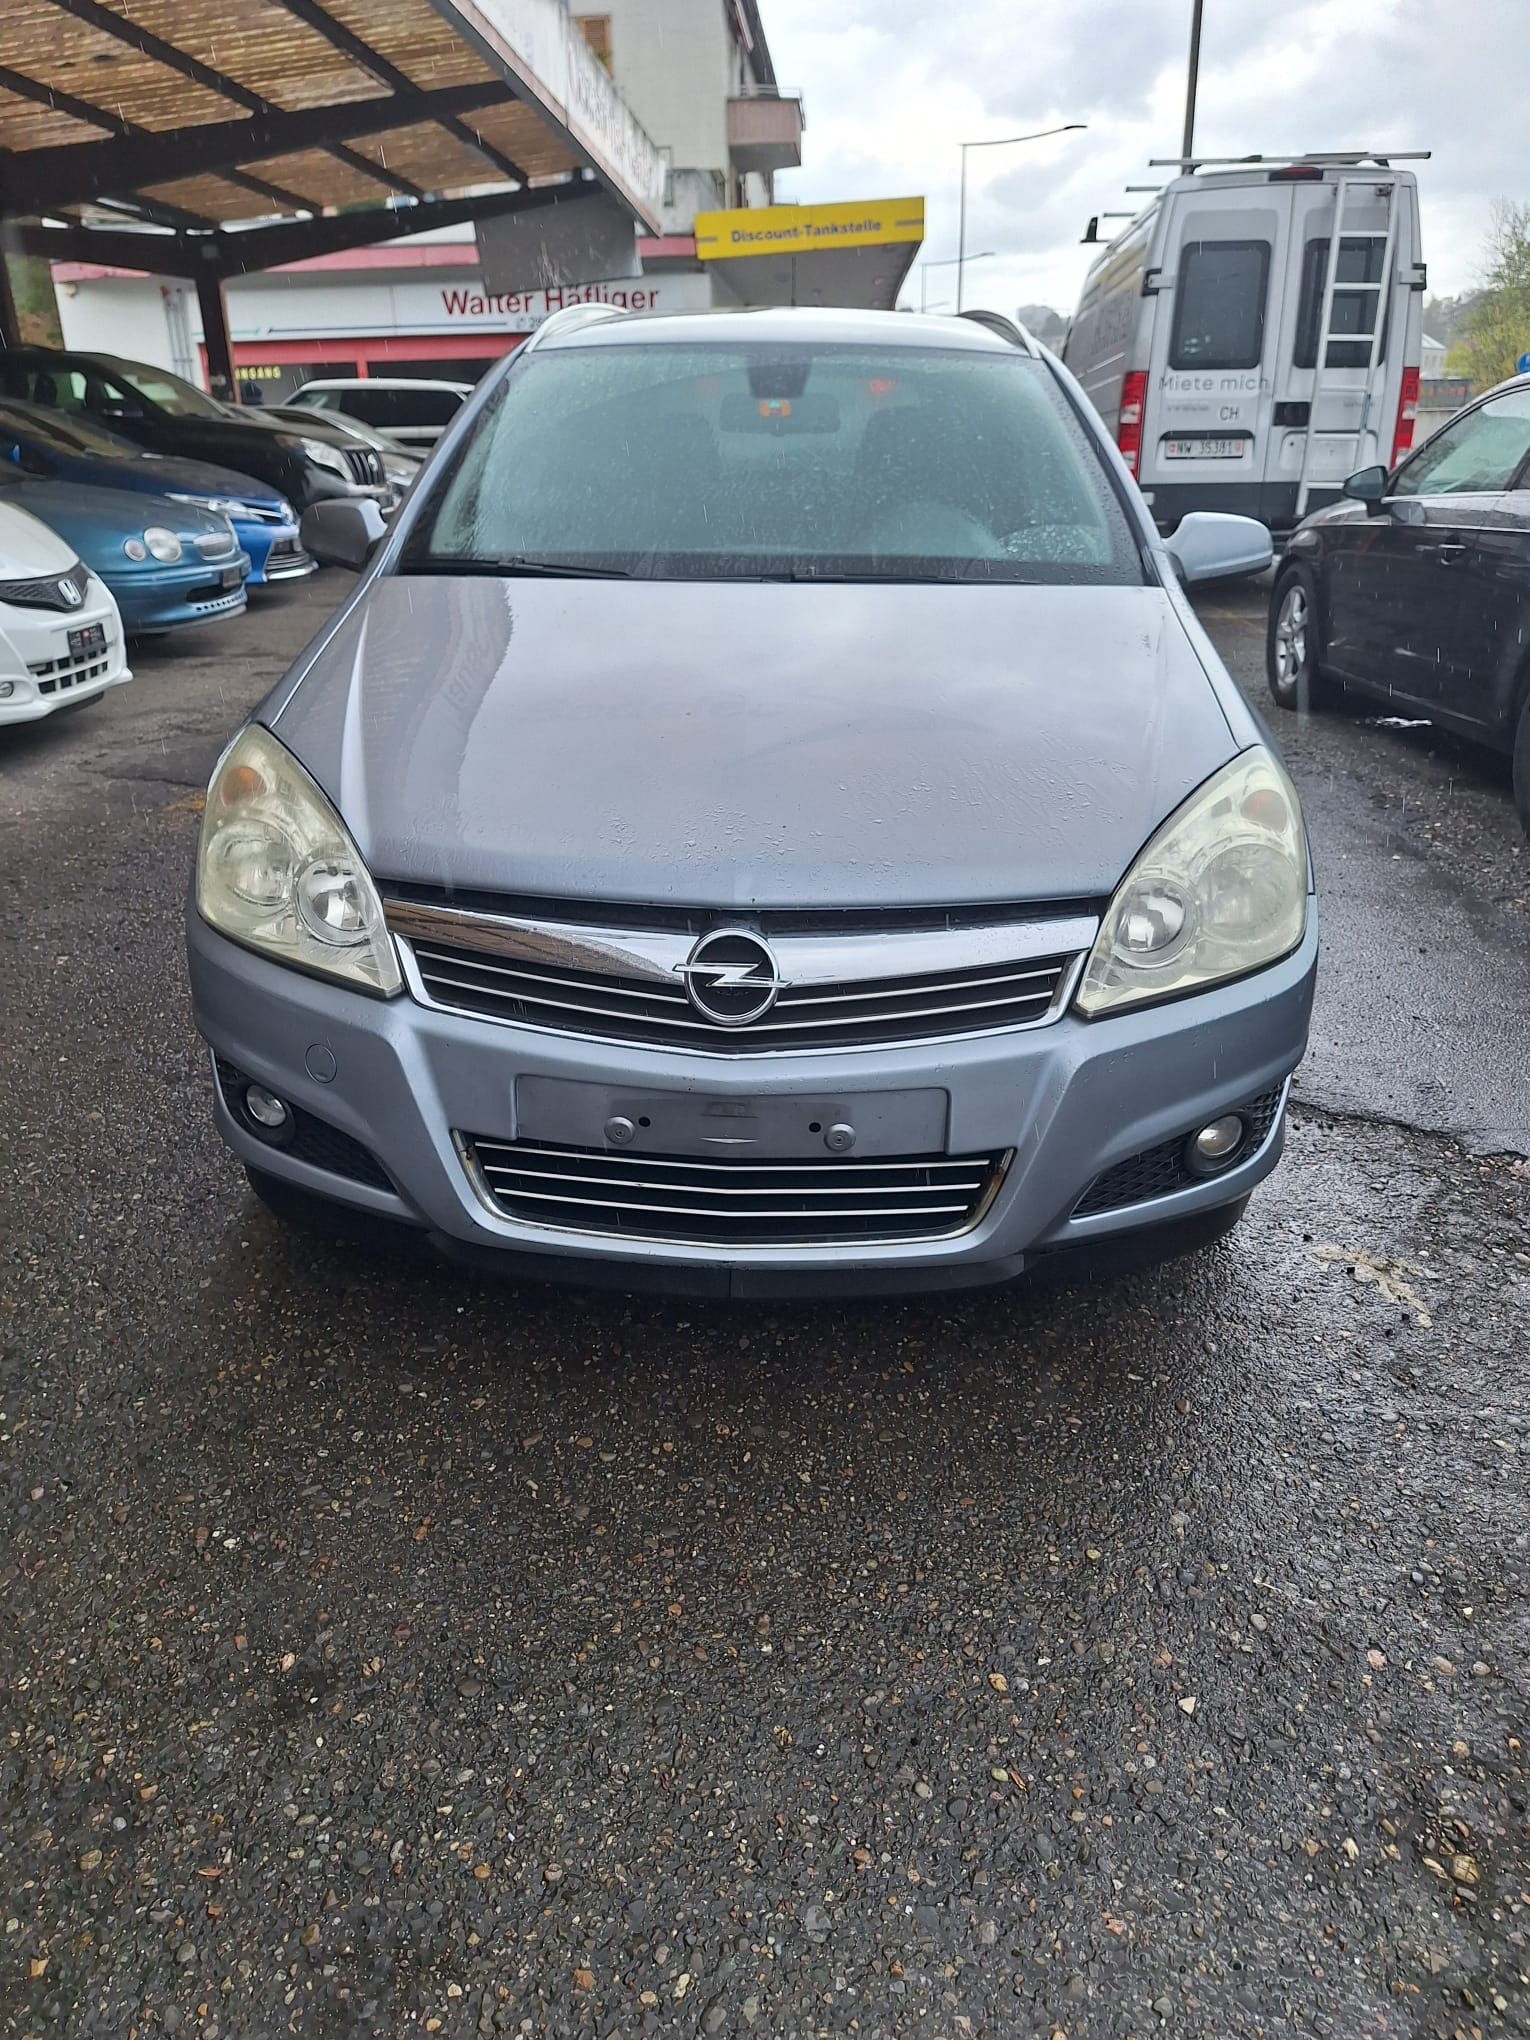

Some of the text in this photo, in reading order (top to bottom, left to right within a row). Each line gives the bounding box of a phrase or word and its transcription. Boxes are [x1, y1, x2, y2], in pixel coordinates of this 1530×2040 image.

[731, 219, 883, 243] Discount-Tankstelle
[441, 289, 534, 315] Walter
[1159, 374, 1269, 392] Miete mich
[1219, 405, 1239, 421] CH
